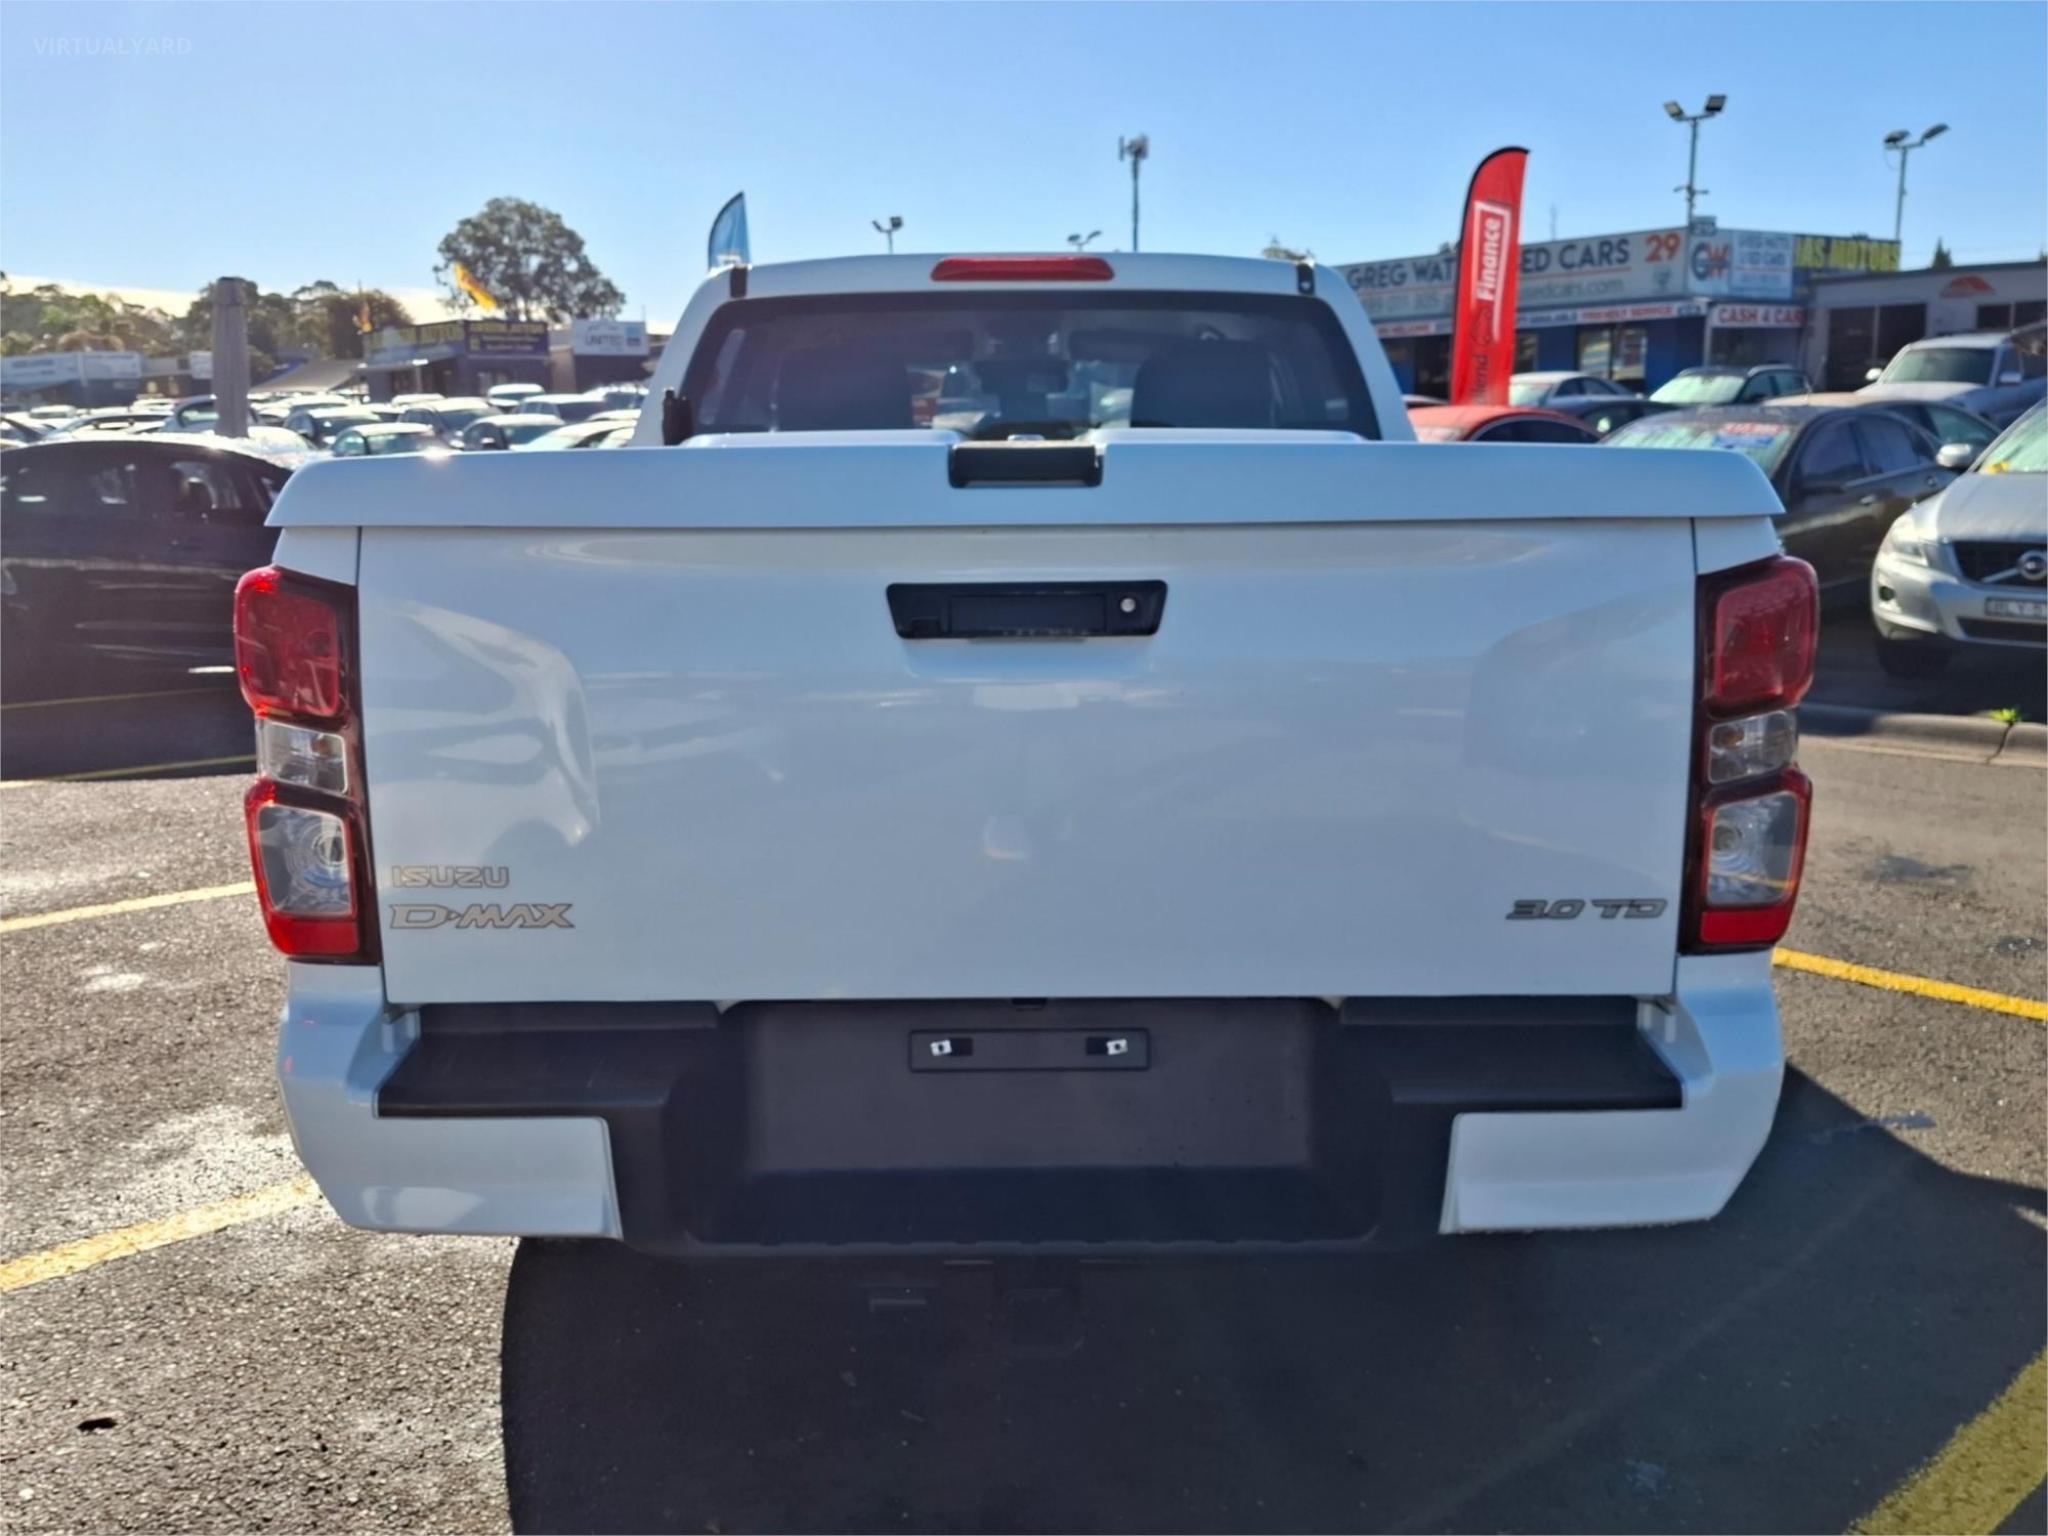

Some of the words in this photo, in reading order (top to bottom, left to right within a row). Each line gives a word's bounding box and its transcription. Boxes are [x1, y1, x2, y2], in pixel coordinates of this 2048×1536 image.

[1346, 262, 1408, 289] GREG
[1412, 257, 1458, 284] WAT
[1519, 248, 1551, 273] ED
[1558, 238, 1630, 270] CARS
[1644, 232, 1681, 263] 29
[1476, 217, 1502, 301] Finance
[1719, 307, 1758, 323] CASH
[391, 865, 510, 889] ISUZU
[1505, 898, 1586, 921] 3.0
[1590, 898, 1668, 920] TD
